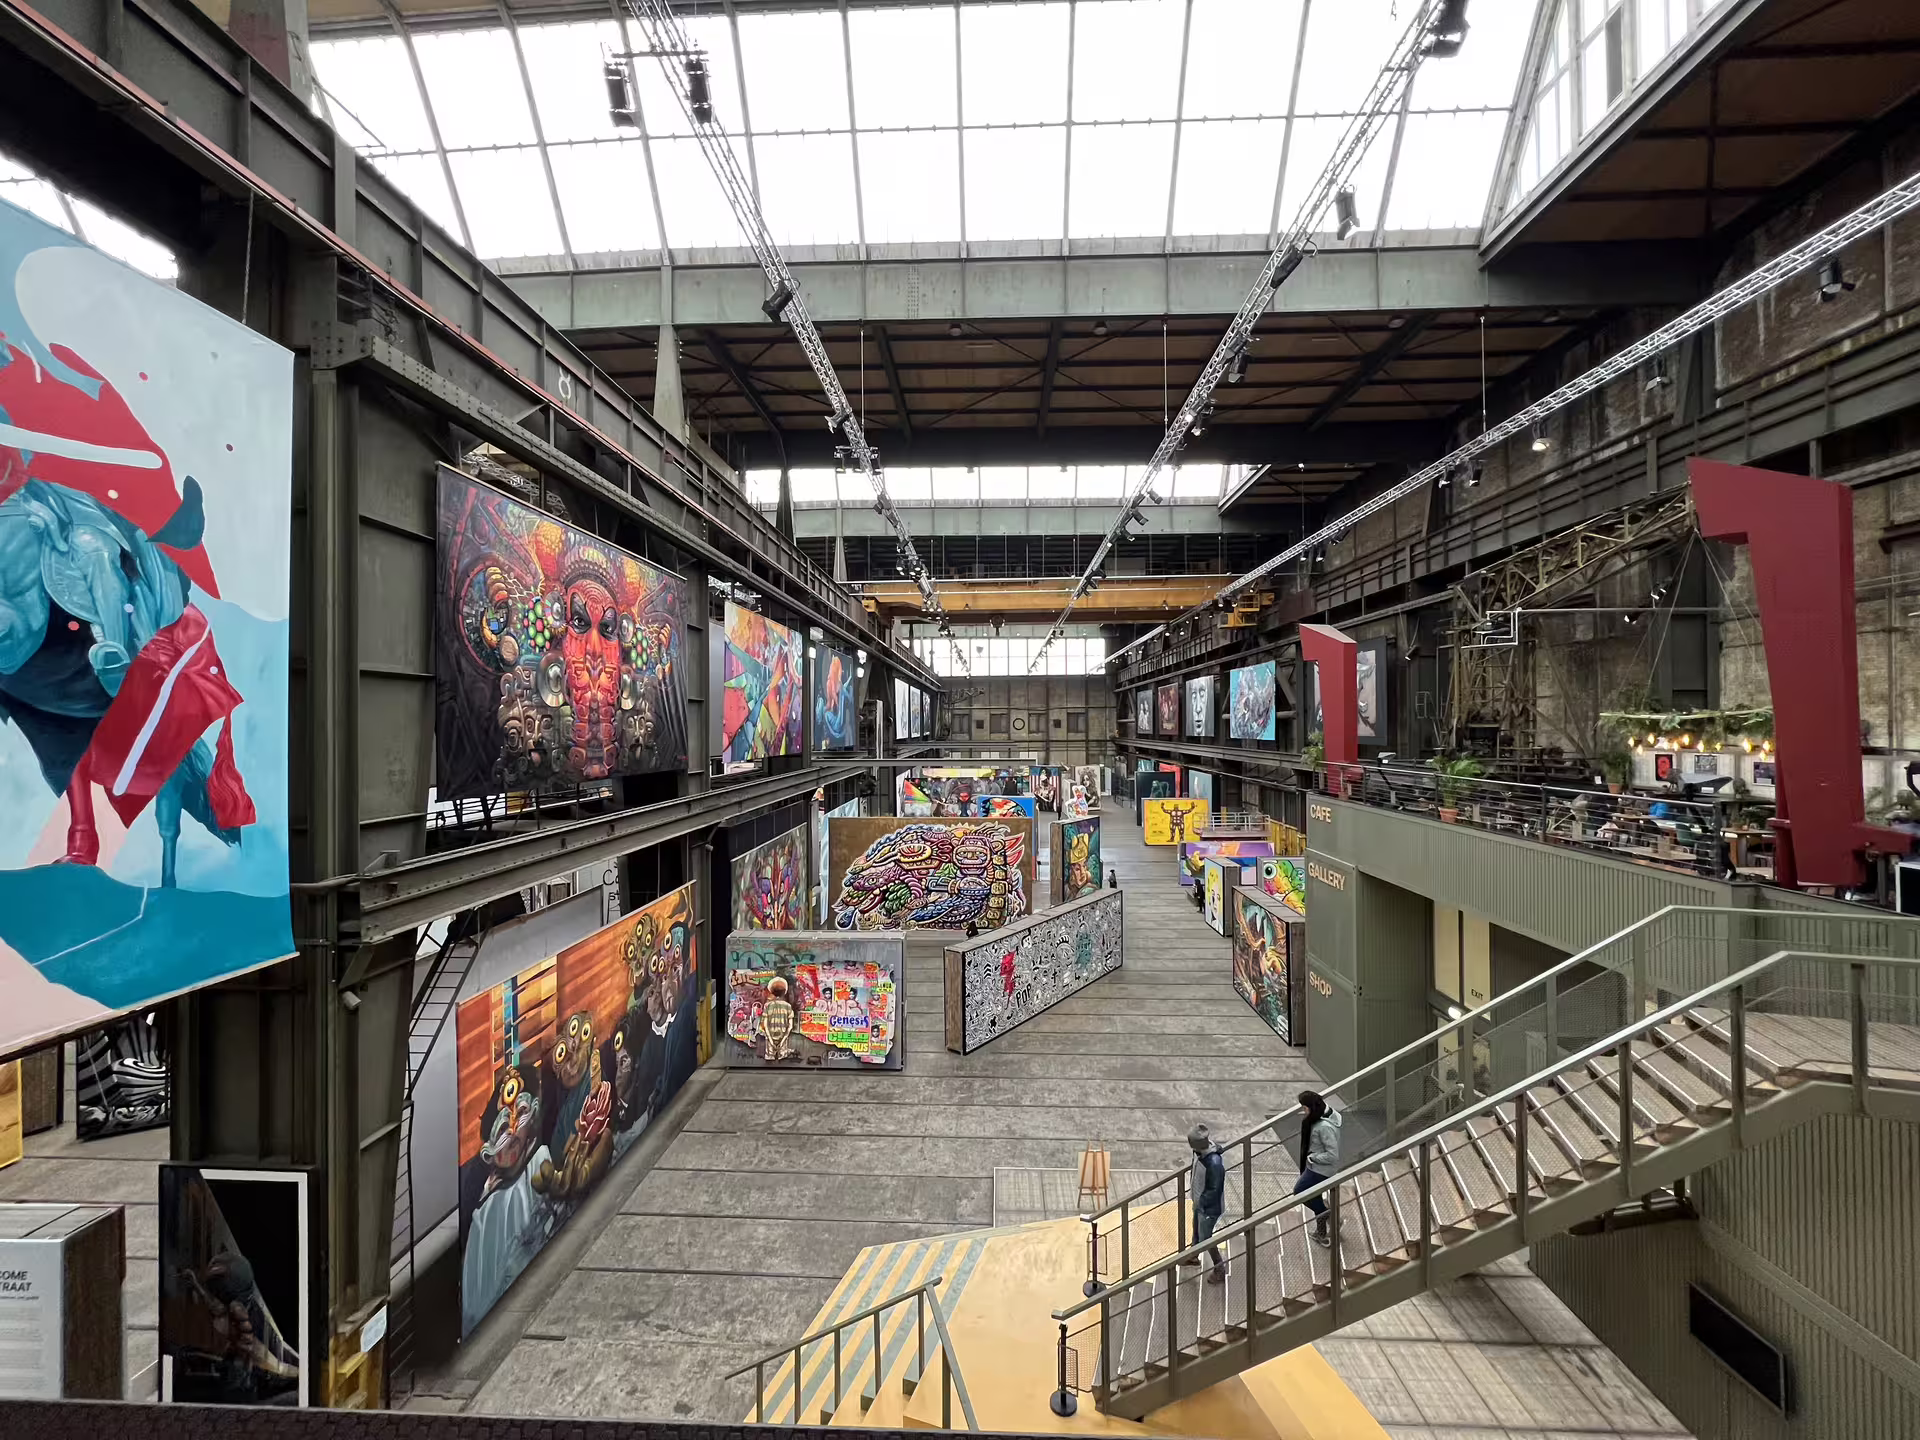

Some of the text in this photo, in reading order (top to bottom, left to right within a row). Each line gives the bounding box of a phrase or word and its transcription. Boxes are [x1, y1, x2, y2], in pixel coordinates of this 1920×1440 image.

[1310, 804, 1331, 822] CAFE
[1308, 862, 1345, 890] GALLERY
[1310, 971, 1331, 998] SHOP
